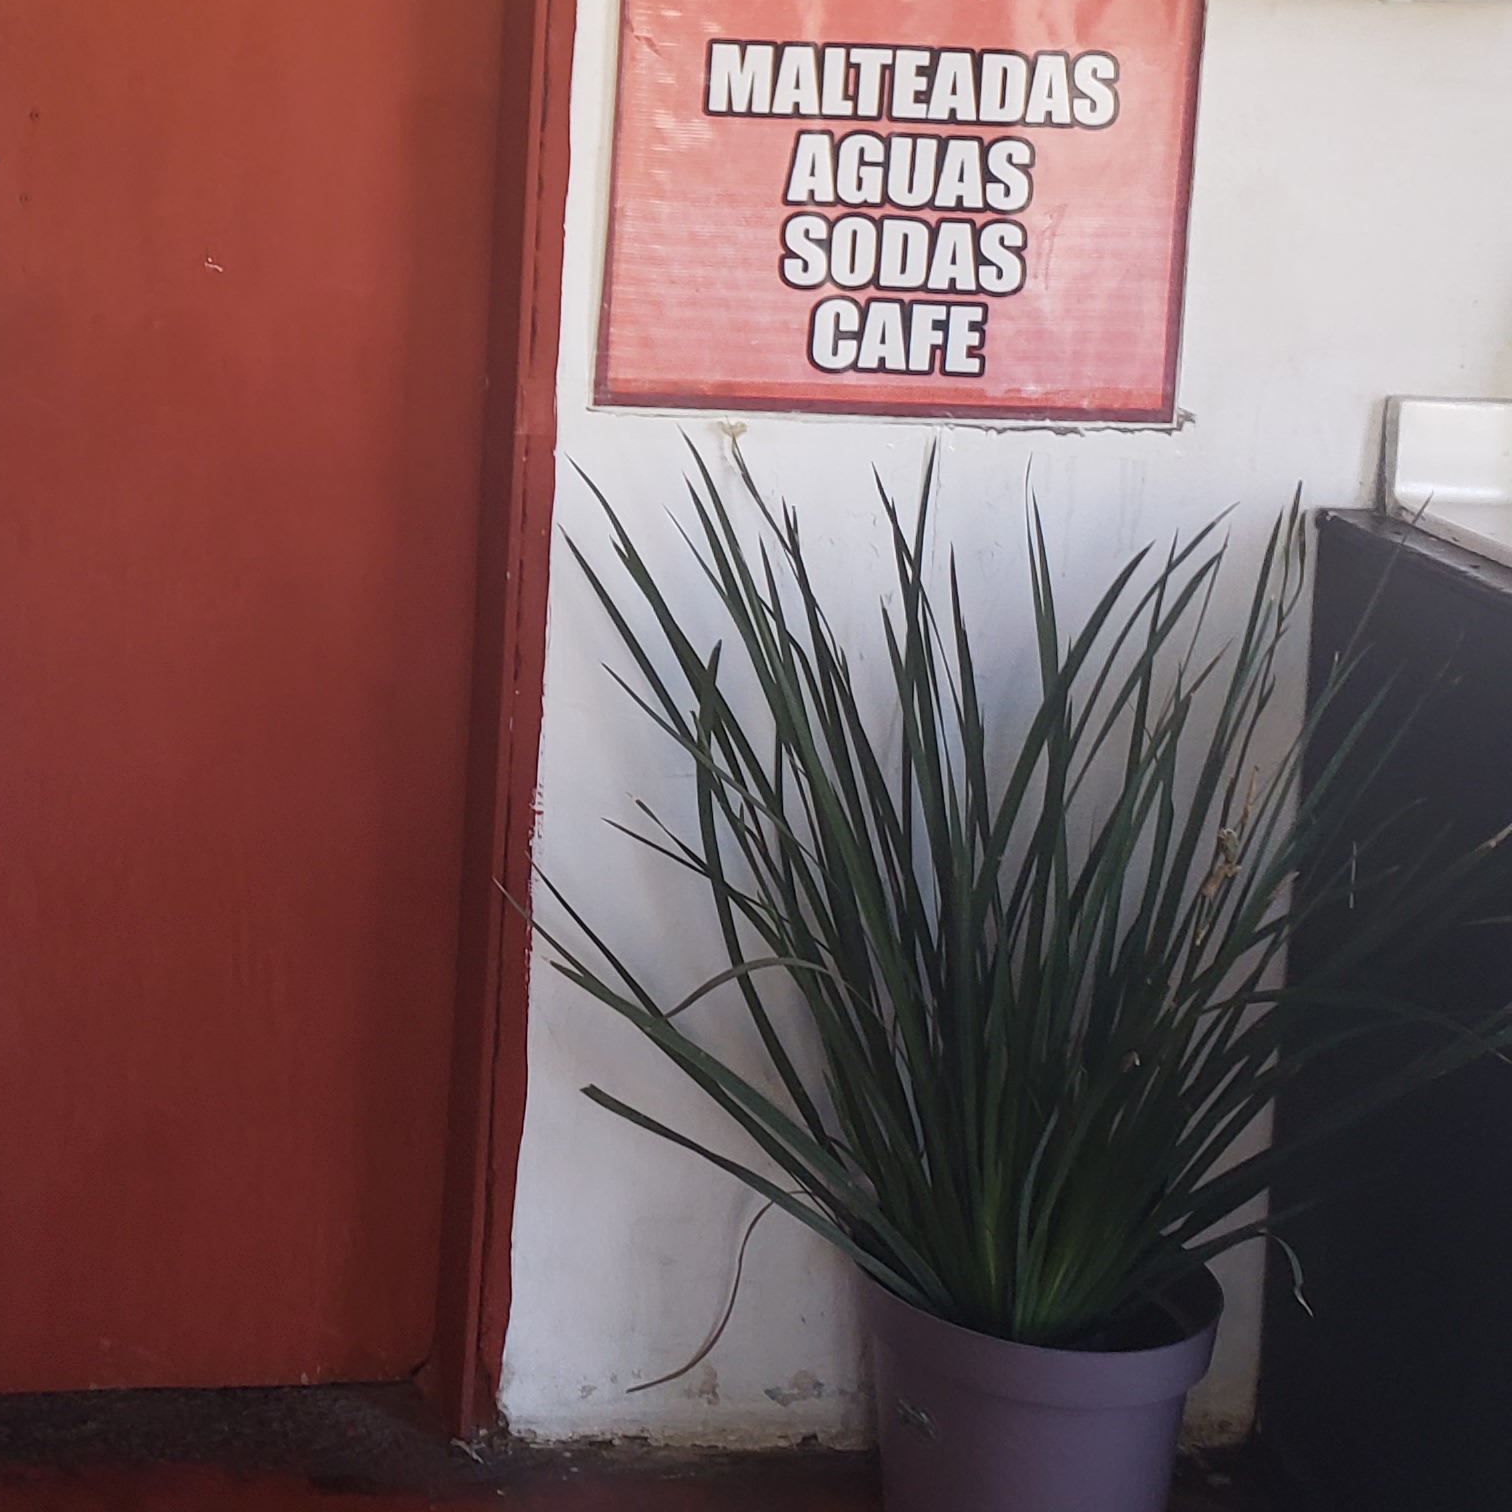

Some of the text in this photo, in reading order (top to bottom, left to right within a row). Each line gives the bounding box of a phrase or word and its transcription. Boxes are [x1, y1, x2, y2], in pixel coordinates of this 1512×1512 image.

[703, 39, 1120, 129] MALTEADAS
[782, 128, 1037, 214] AGUAS
[779, 213, 1028, 297] SODAS
[807, 295, 988, 377] CAFE
